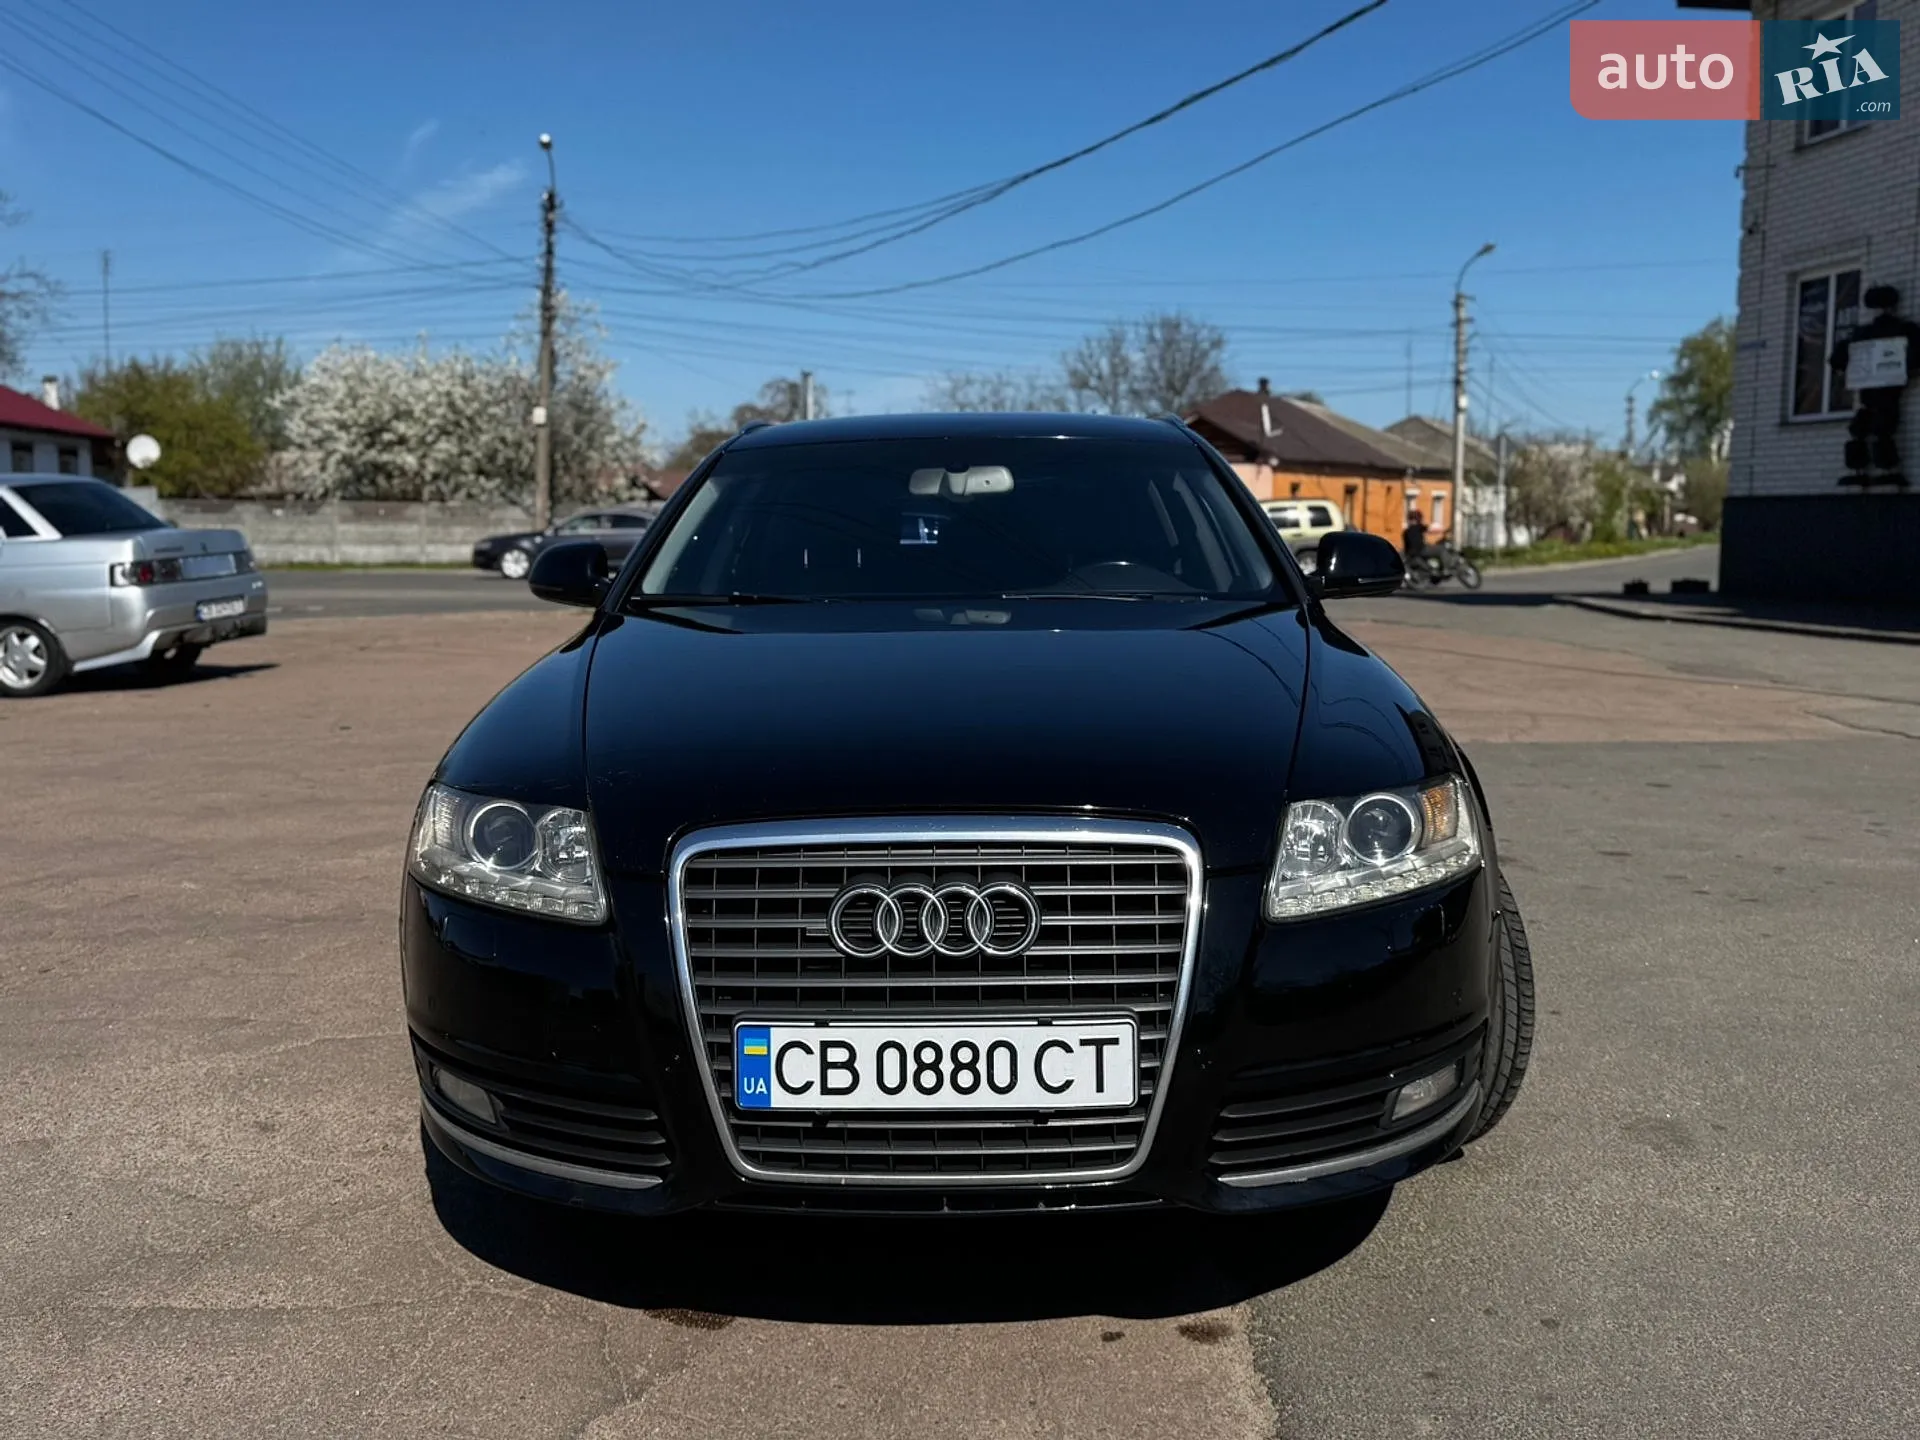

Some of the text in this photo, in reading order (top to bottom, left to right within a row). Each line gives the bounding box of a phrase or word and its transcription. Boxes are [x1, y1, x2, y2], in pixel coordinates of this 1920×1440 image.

[775, 1038, 1119, 1095] CB 0880 CT
[744, 1079, 767, 1095] UA
